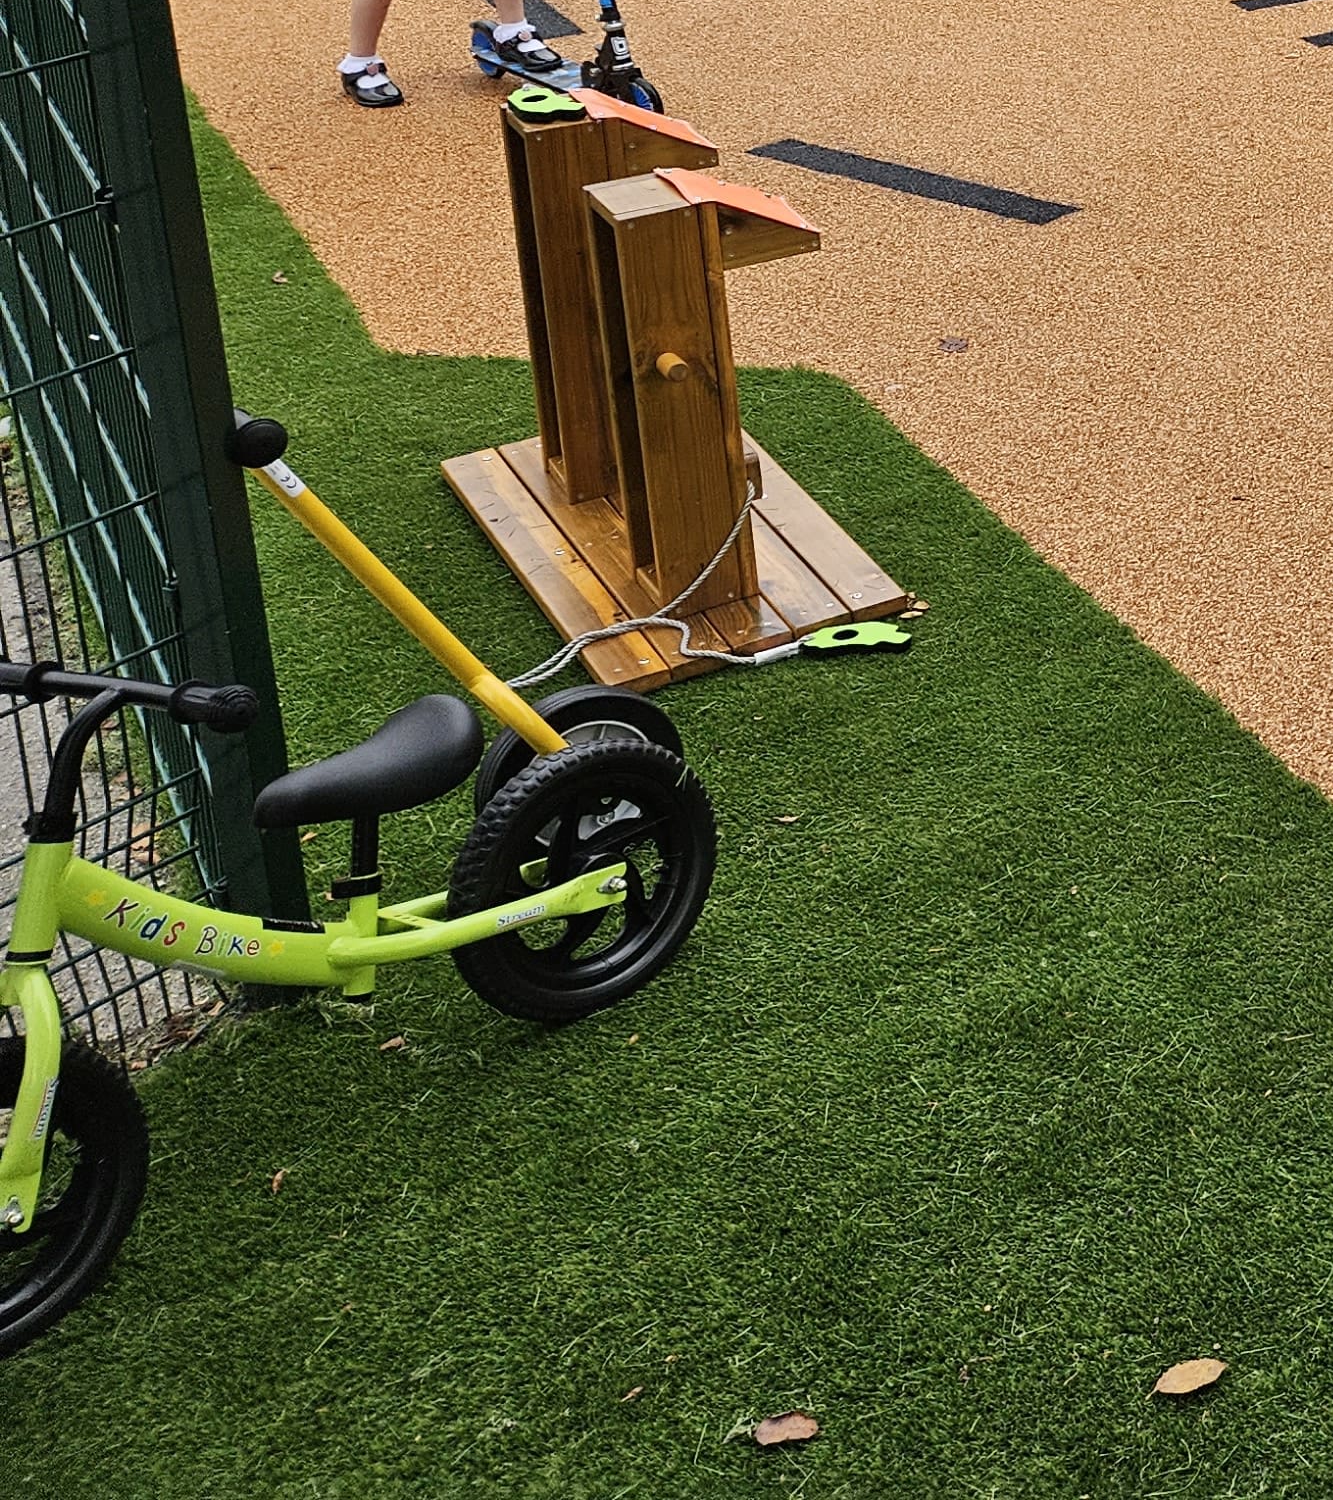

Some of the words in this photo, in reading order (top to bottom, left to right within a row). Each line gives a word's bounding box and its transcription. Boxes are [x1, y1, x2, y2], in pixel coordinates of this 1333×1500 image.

[103, 898, 186, 946] Kids
[195, 925, 260, 956] Bike
[497, 905, 545, 927] Stream
